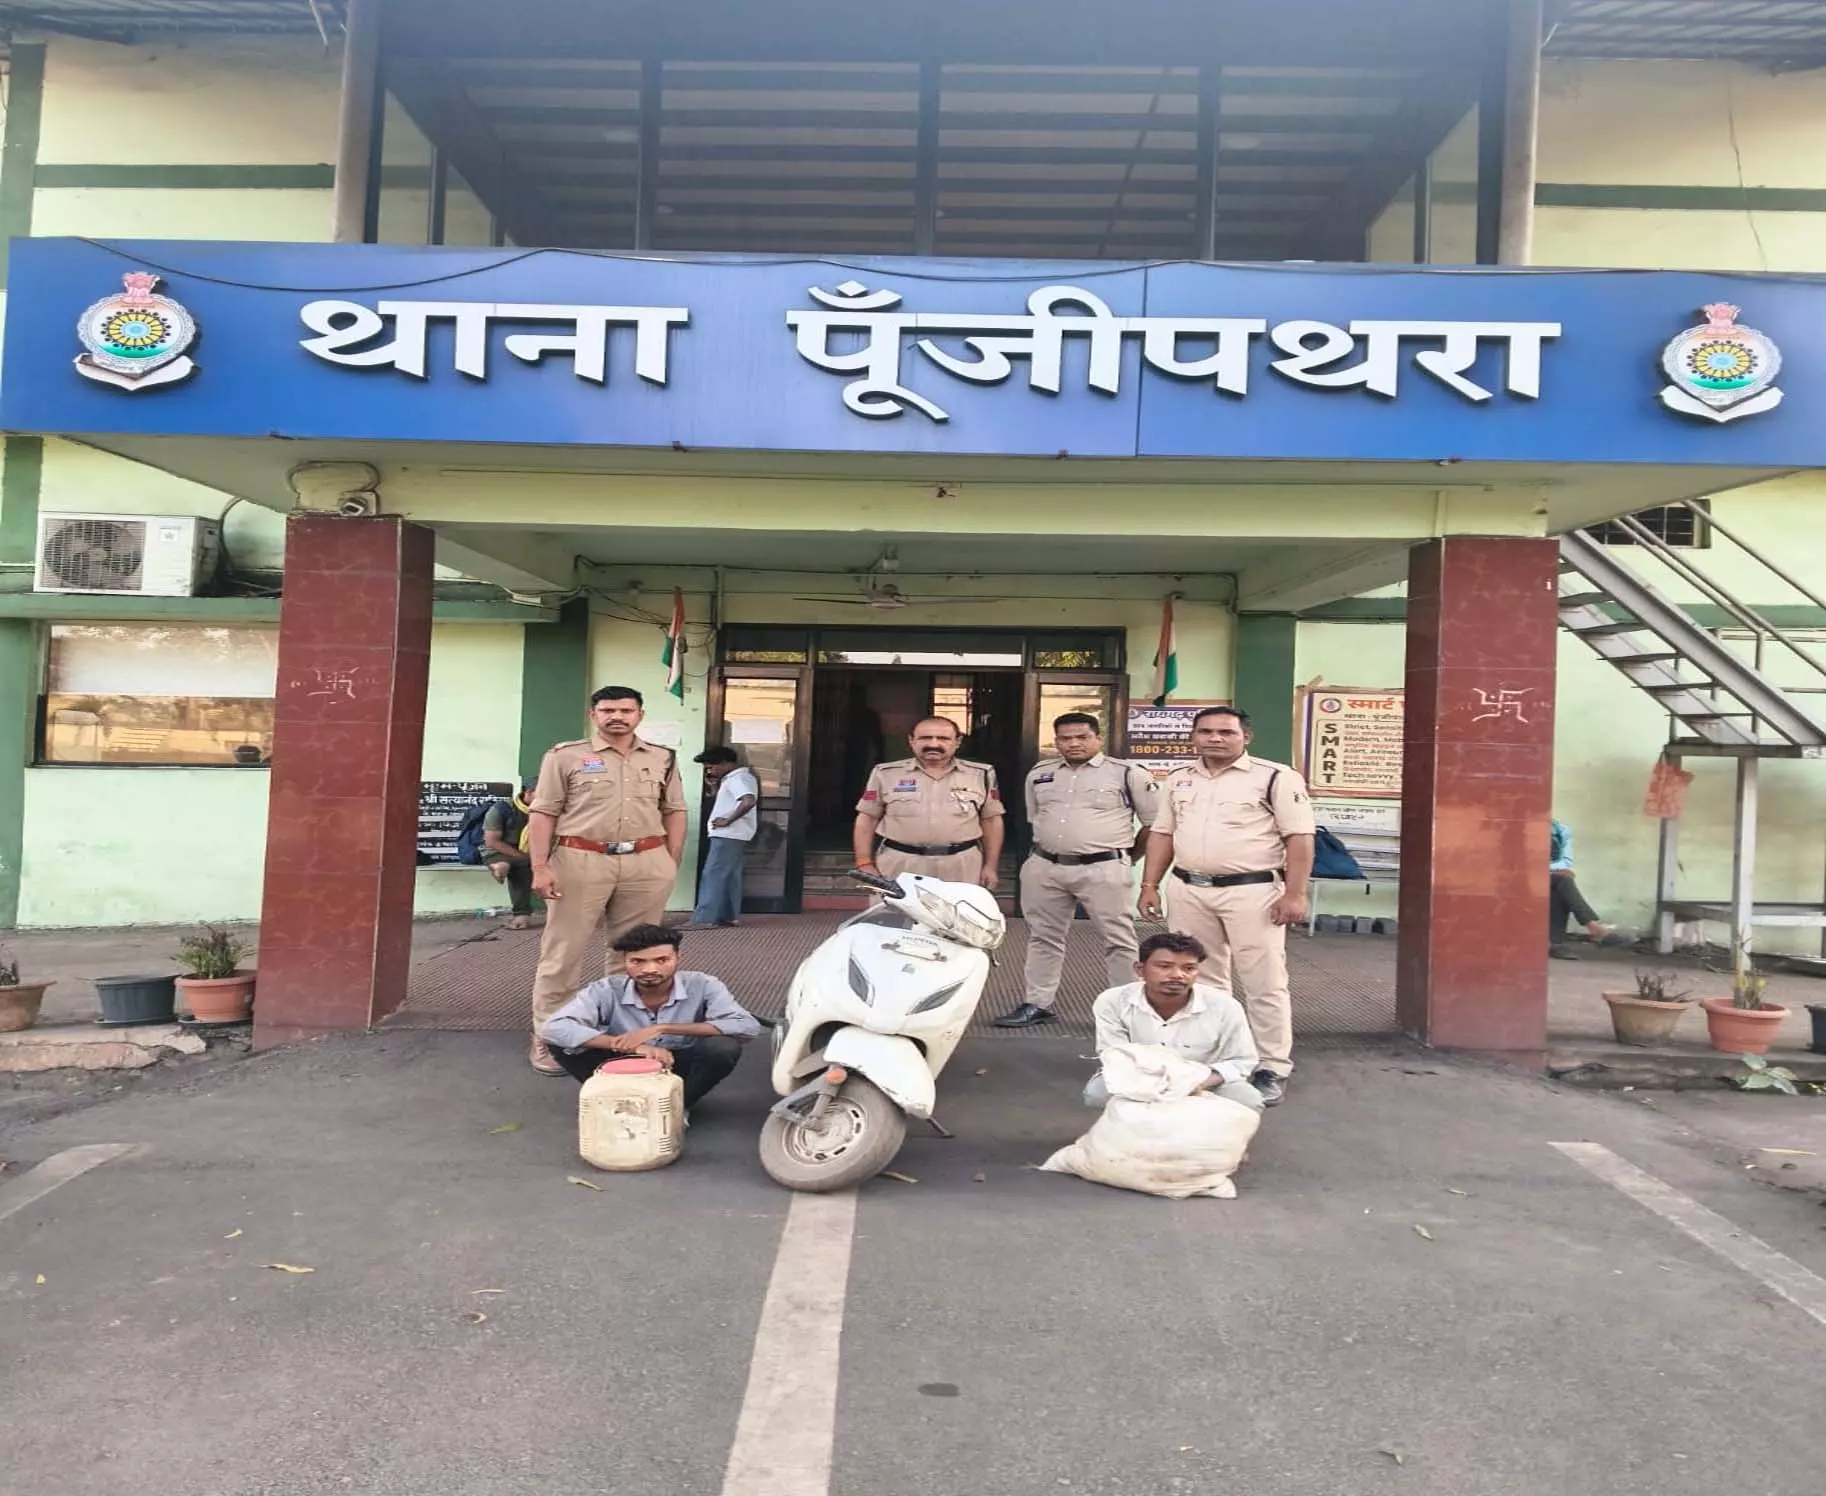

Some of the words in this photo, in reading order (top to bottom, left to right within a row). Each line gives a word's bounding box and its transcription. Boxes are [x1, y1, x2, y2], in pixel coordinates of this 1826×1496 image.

[299, 299, 689, 386] थाना
[785, 281, 1563, 424] पूँजीपथरा
[1347, 697, 1395, 710] स्मार्ट
[1130, 745, 1198, 754] 1800-233-1
